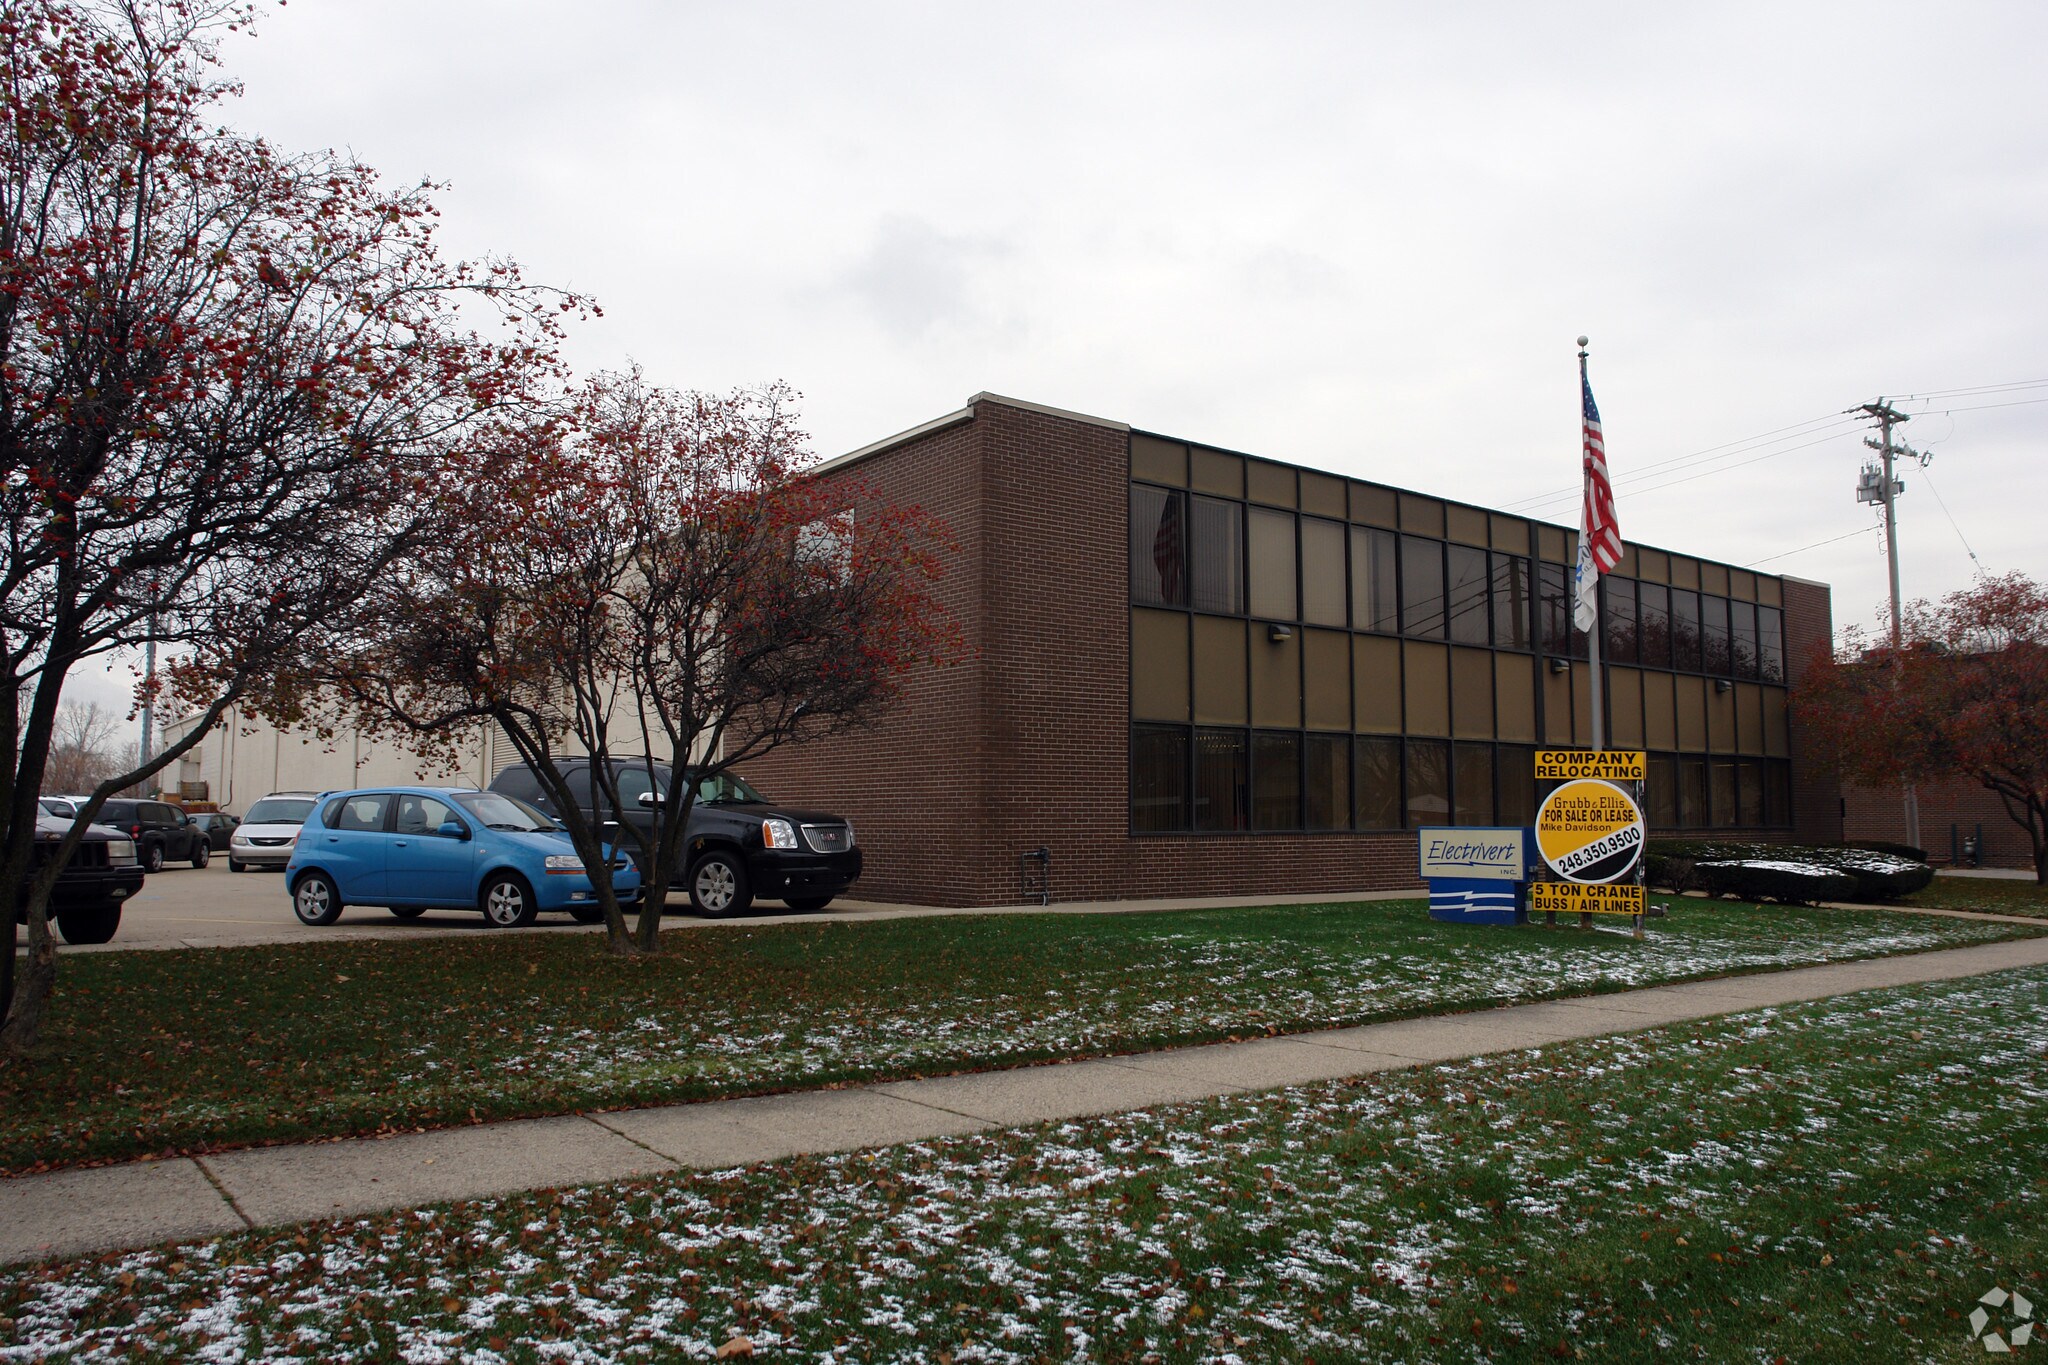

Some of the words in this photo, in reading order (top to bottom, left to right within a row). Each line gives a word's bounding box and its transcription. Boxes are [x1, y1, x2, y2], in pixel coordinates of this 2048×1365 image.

[1541, 752, 1636, 765] COMPANY
[1536, 766, 1642, 778] RELOCATING
[1554, 797, 1590, 809] Grubb
[1600, 797, 1625, 809] Ellis
[1545, 809, 1562, 822] FOR
[1565, 809, 1587, 822] SALE
[1589, 809, 1602, 822] OR
[1605, 809, 1634, 822] LEASE
[1540, 823, 1562, 831] Mike
[1565, 823, 1612, 832] Davidson
[1427, 840, 1516, 861] Electrivert
[1558, 827, 1641, 874] 248.350.9500
[1535, 884, 1544, 895] 5
[1549, 884, 1581, 897] TON
[1586, 885, 1640, 898] CRANE
[1535, 897, 1568, 910] BUSS
[1580, 899, 1600, 911] AIR
[1604, 900, 1640, 913] LINES
